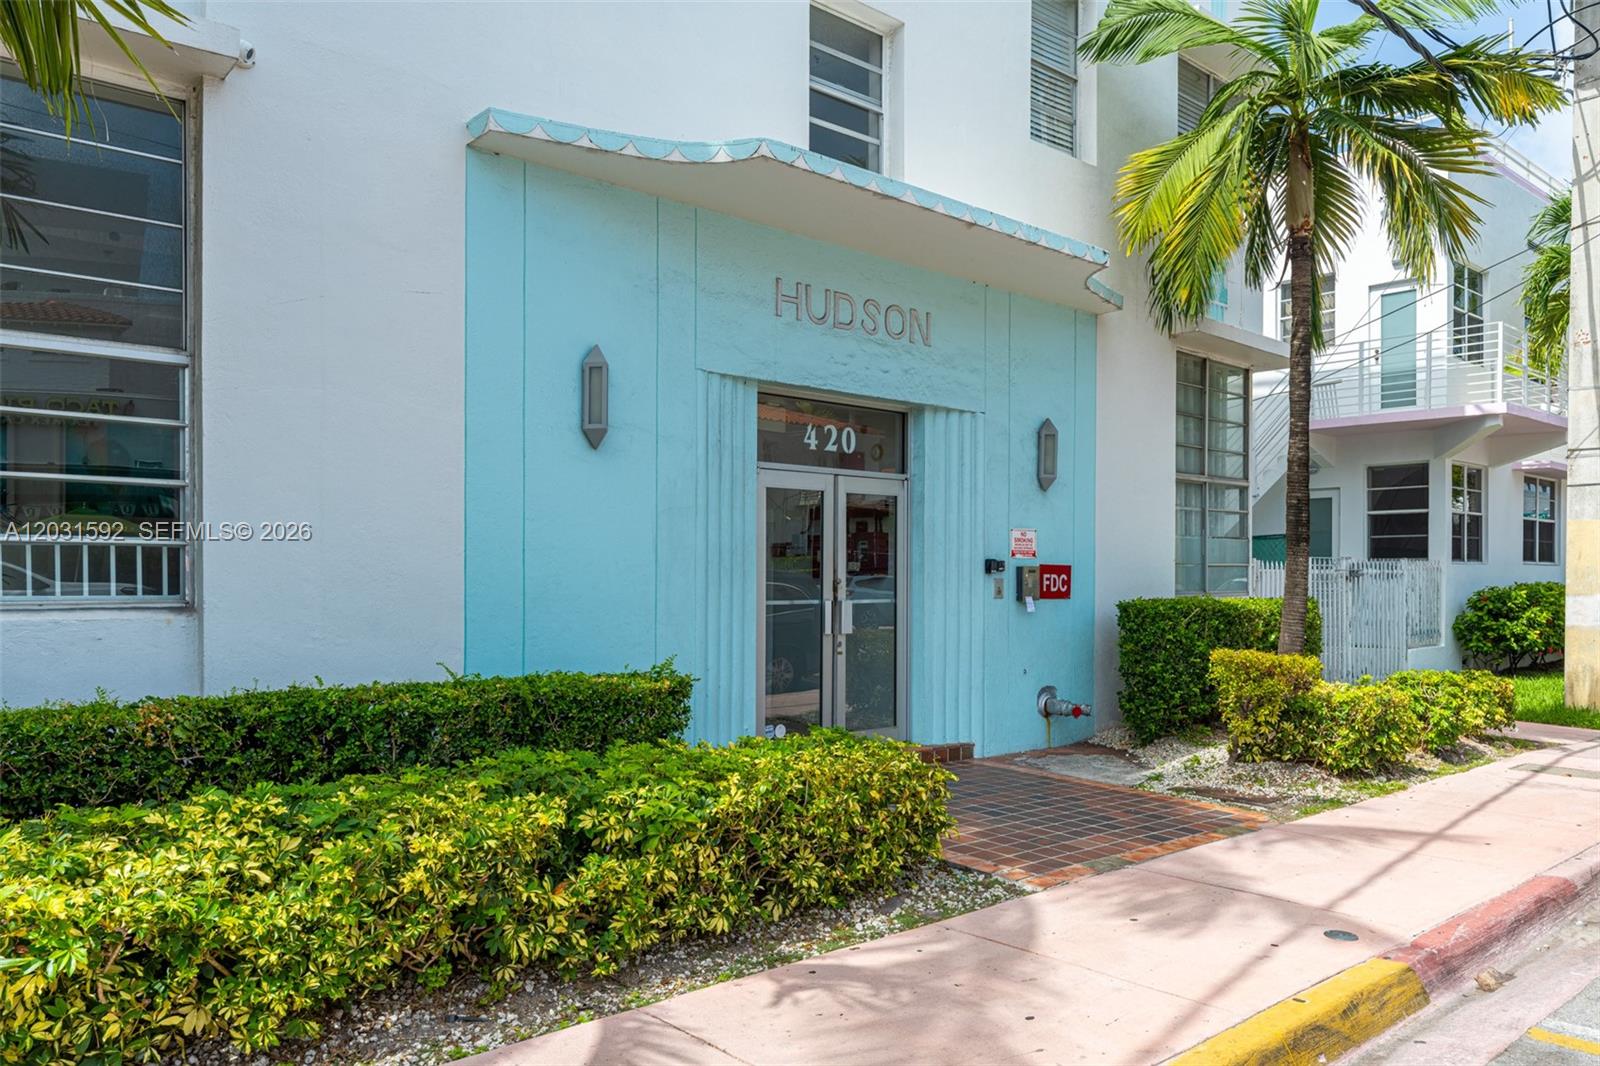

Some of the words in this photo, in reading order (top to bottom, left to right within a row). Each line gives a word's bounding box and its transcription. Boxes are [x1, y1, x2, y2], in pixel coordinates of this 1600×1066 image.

[775, 277, 932, 347] HUDSON
[803, 423, 856, 454] 420
[1043, 574, 1068, 592] FDC
